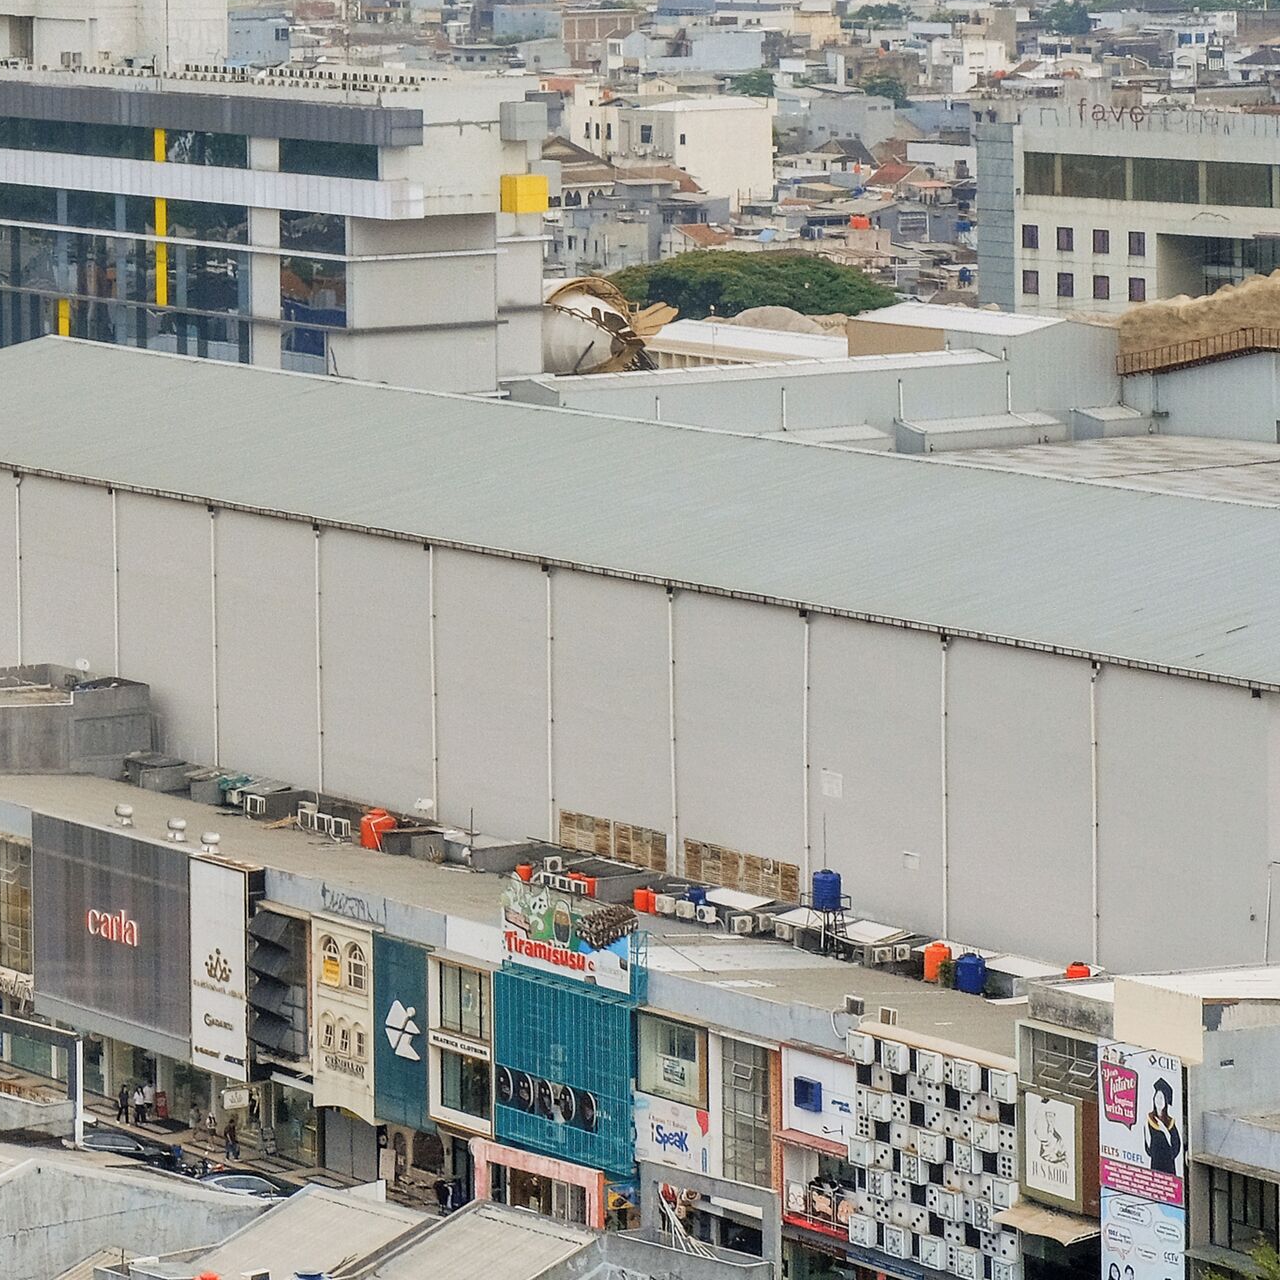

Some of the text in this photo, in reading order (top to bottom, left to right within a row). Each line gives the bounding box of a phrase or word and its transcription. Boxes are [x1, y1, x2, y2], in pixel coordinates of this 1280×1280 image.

[86, 909, 139, 947] carla
[504, 930, 585, 971] Tiramisusu
[432, 1035, 459, 1049] BEATRICE
[1158, 1056, 1178, 1072] CIE
[1110, 1077, 1135, 1100] future
[1106, 1102, 1134, 1119] with us
[1101, 1144, 1145, 1164] IELTS TOEFL
